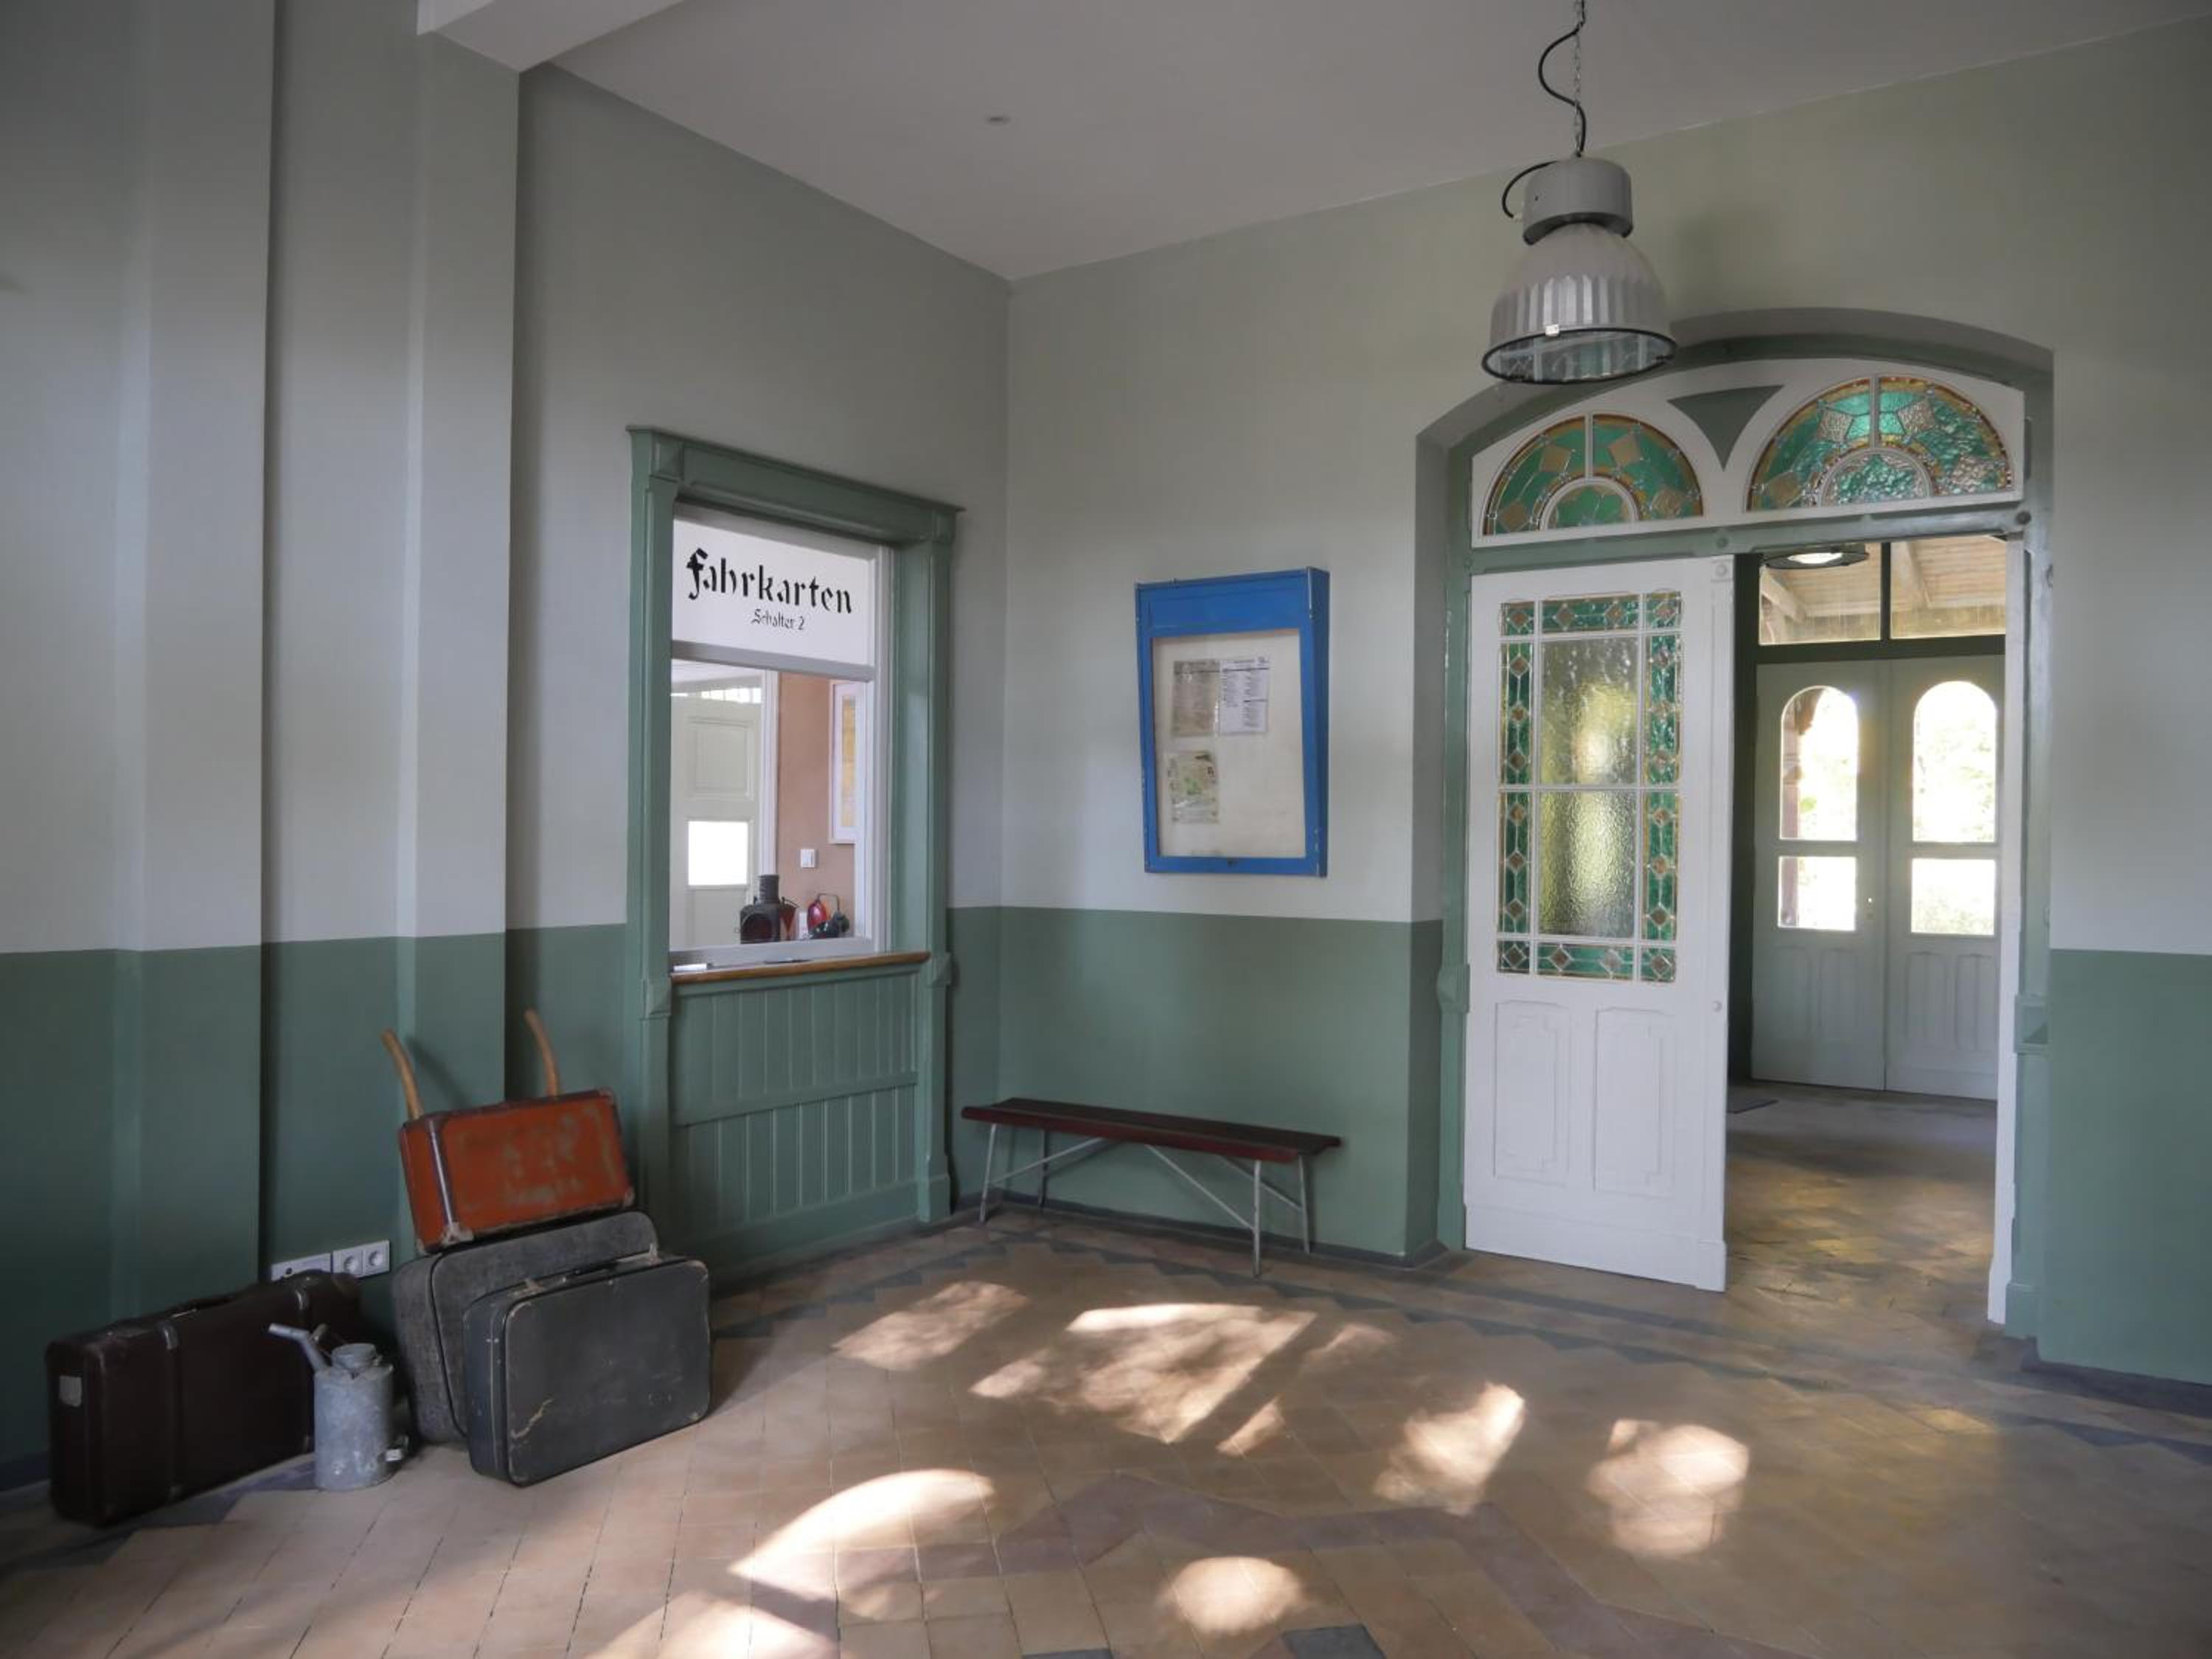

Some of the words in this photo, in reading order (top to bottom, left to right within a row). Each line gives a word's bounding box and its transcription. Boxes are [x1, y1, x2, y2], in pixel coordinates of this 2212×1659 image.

[686, 547, 852, 614] Fahrkarten
[751, 608, 794, 629] Schalter
[797, 615, 805, 630] 2
